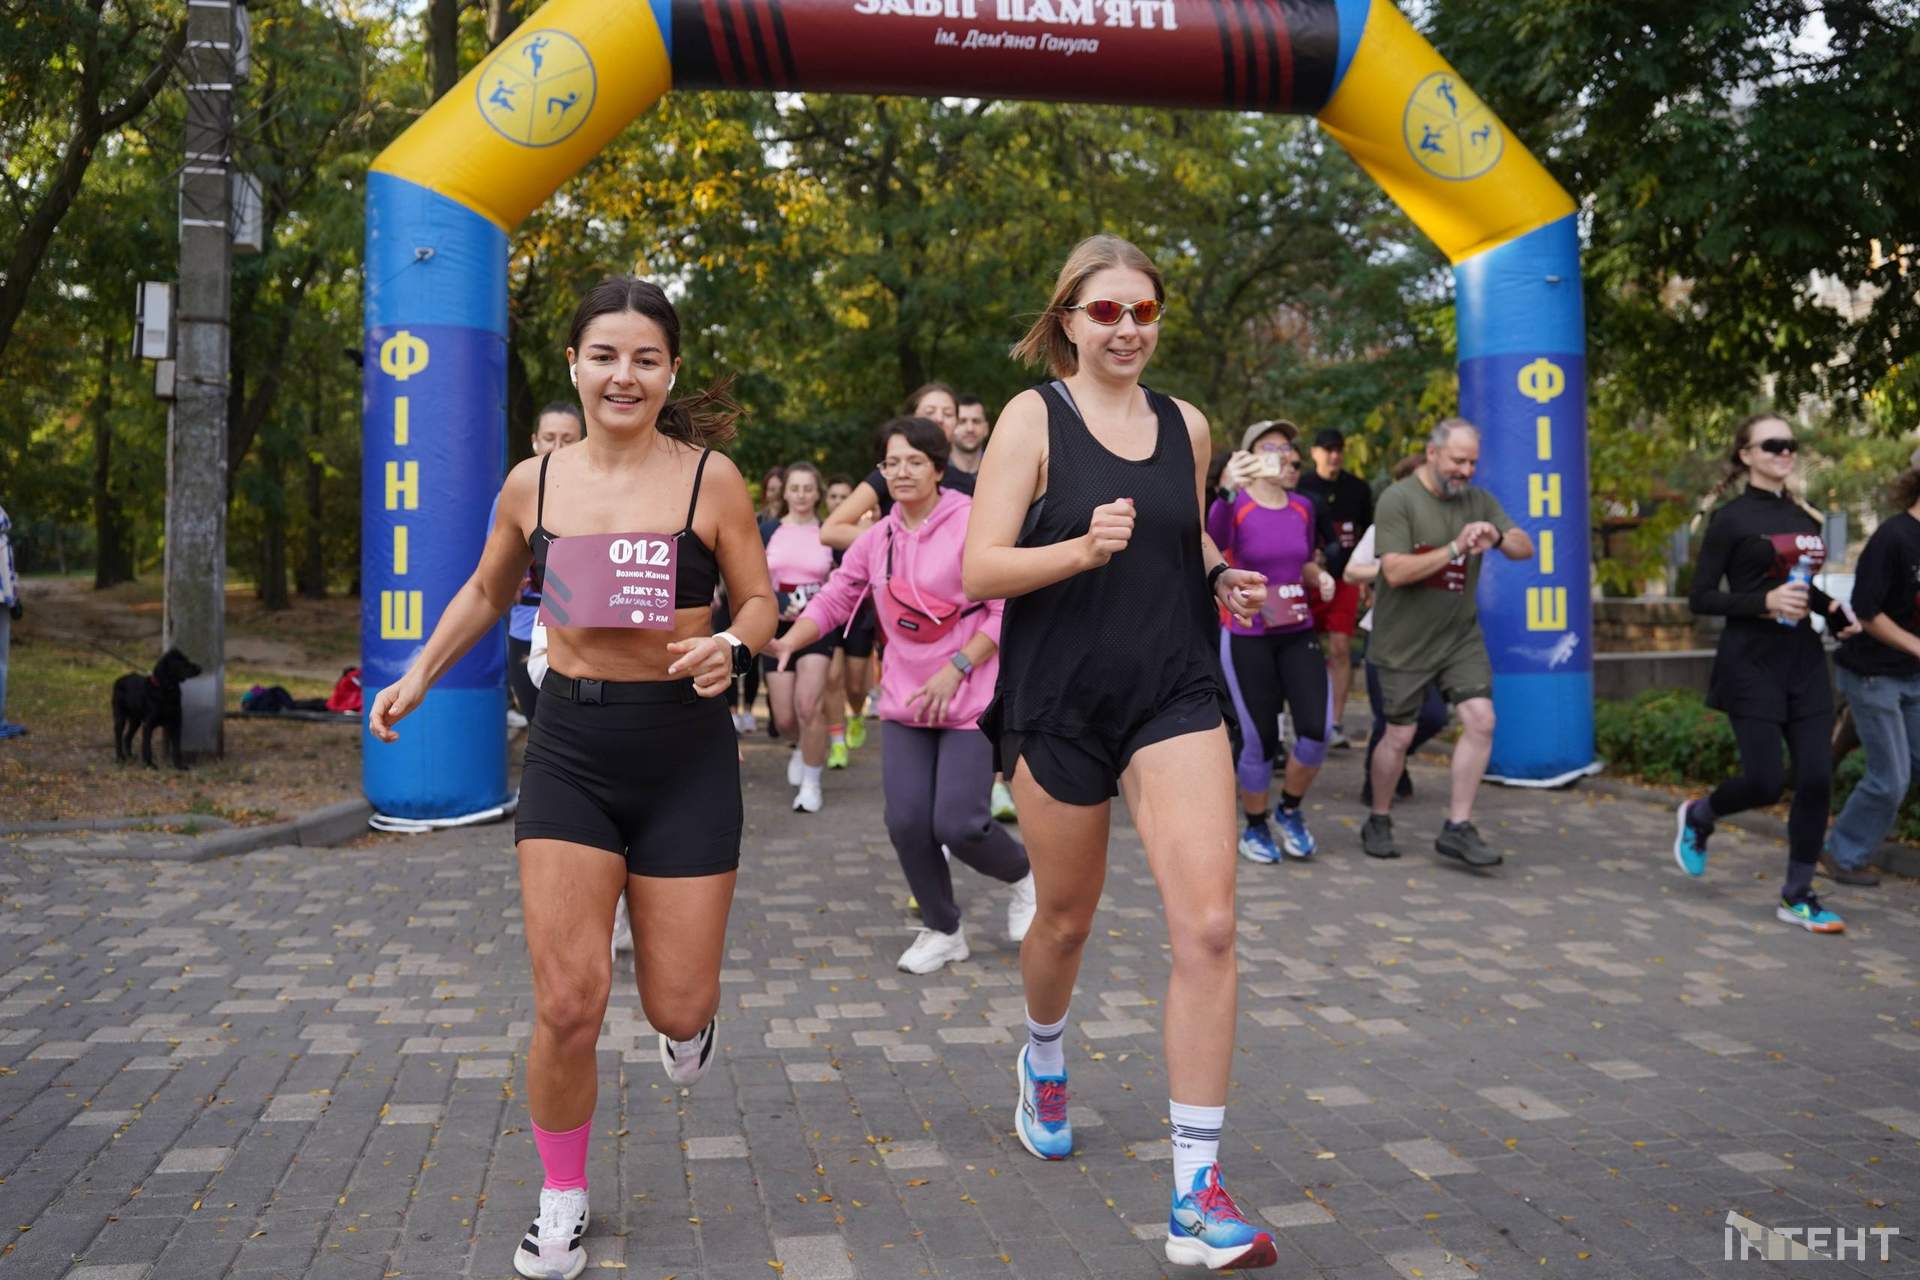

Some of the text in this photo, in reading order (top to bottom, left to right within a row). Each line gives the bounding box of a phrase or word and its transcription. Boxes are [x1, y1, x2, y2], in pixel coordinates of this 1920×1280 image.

[934, 27, 959, 46] ім.
[961, 29, 1037, 50] Дем'яна
[379, 330, 430, 640] ФІНІШ
[1517, 357, 1566, 632] ФІНІШ
[609, 539, 671, 567] 012
[645, 570, 670, 581] Жанна
[622, 585, 670, 598] БІЖУ ЗА
[647, 612, 655, 622] 5
